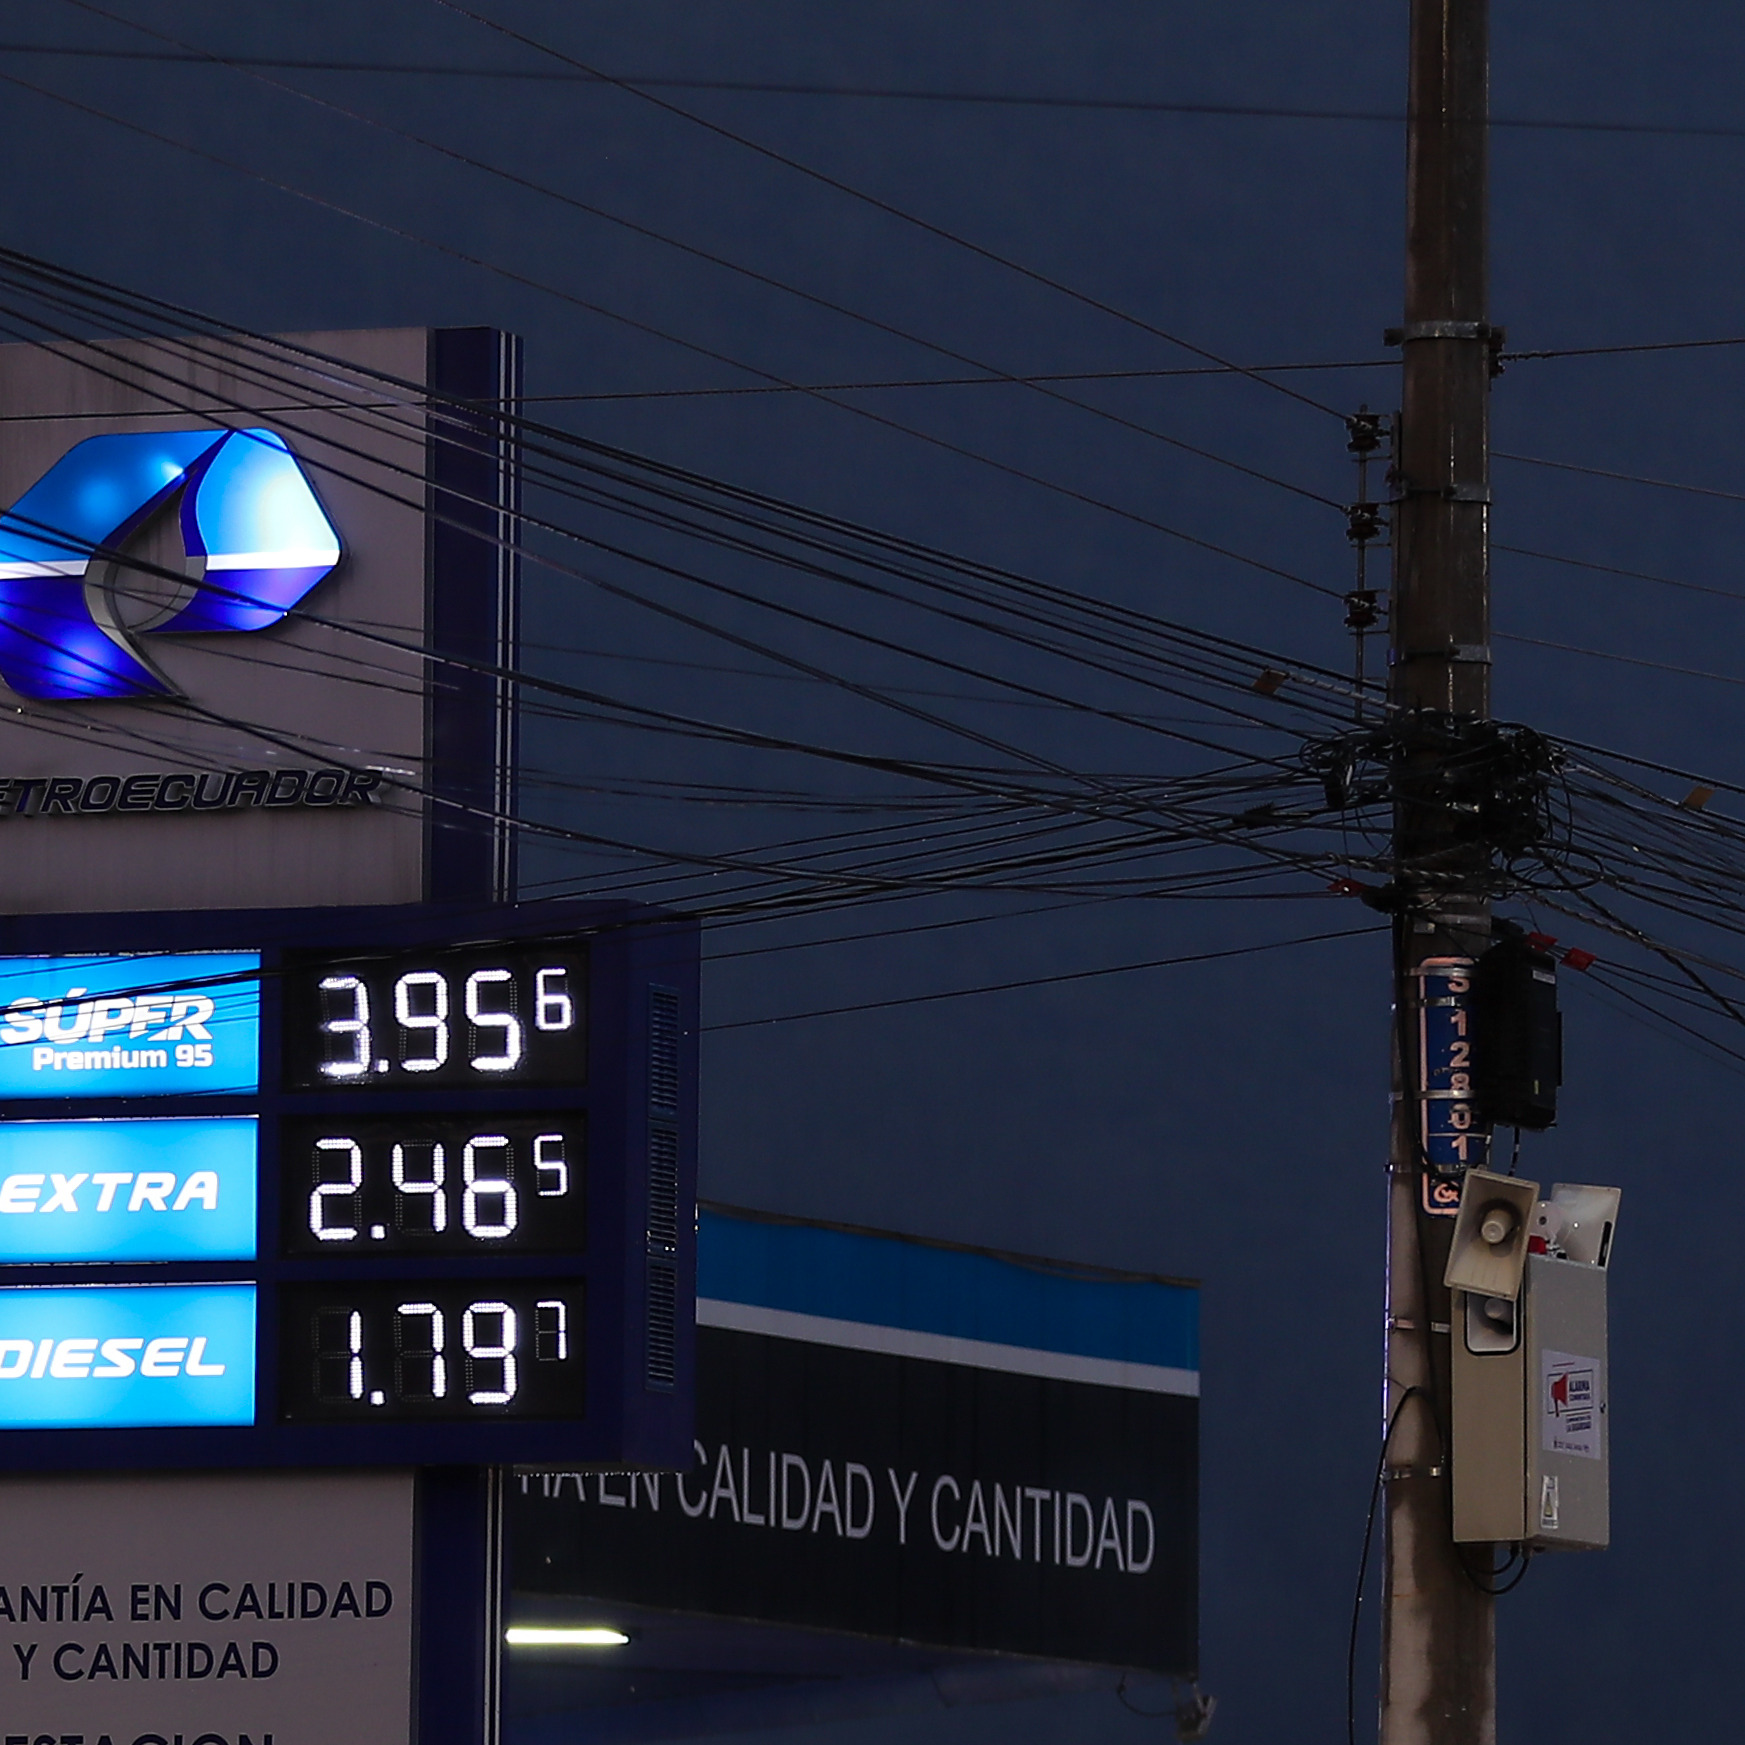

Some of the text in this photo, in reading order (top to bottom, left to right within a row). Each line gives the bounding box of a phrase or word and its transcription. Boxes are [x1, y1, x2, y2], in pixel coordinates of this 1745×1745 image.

[32, 1044, 215, 1071] Premium 95
[675, 1440, 1156, 1576] CALIDAD Y CANTIDAD
[130, 1583, 183, 1622] EN
[198, 1580, 394, 1622] CALIDAD
[13, 1641, 280, 1681] Y CANTIDAD
